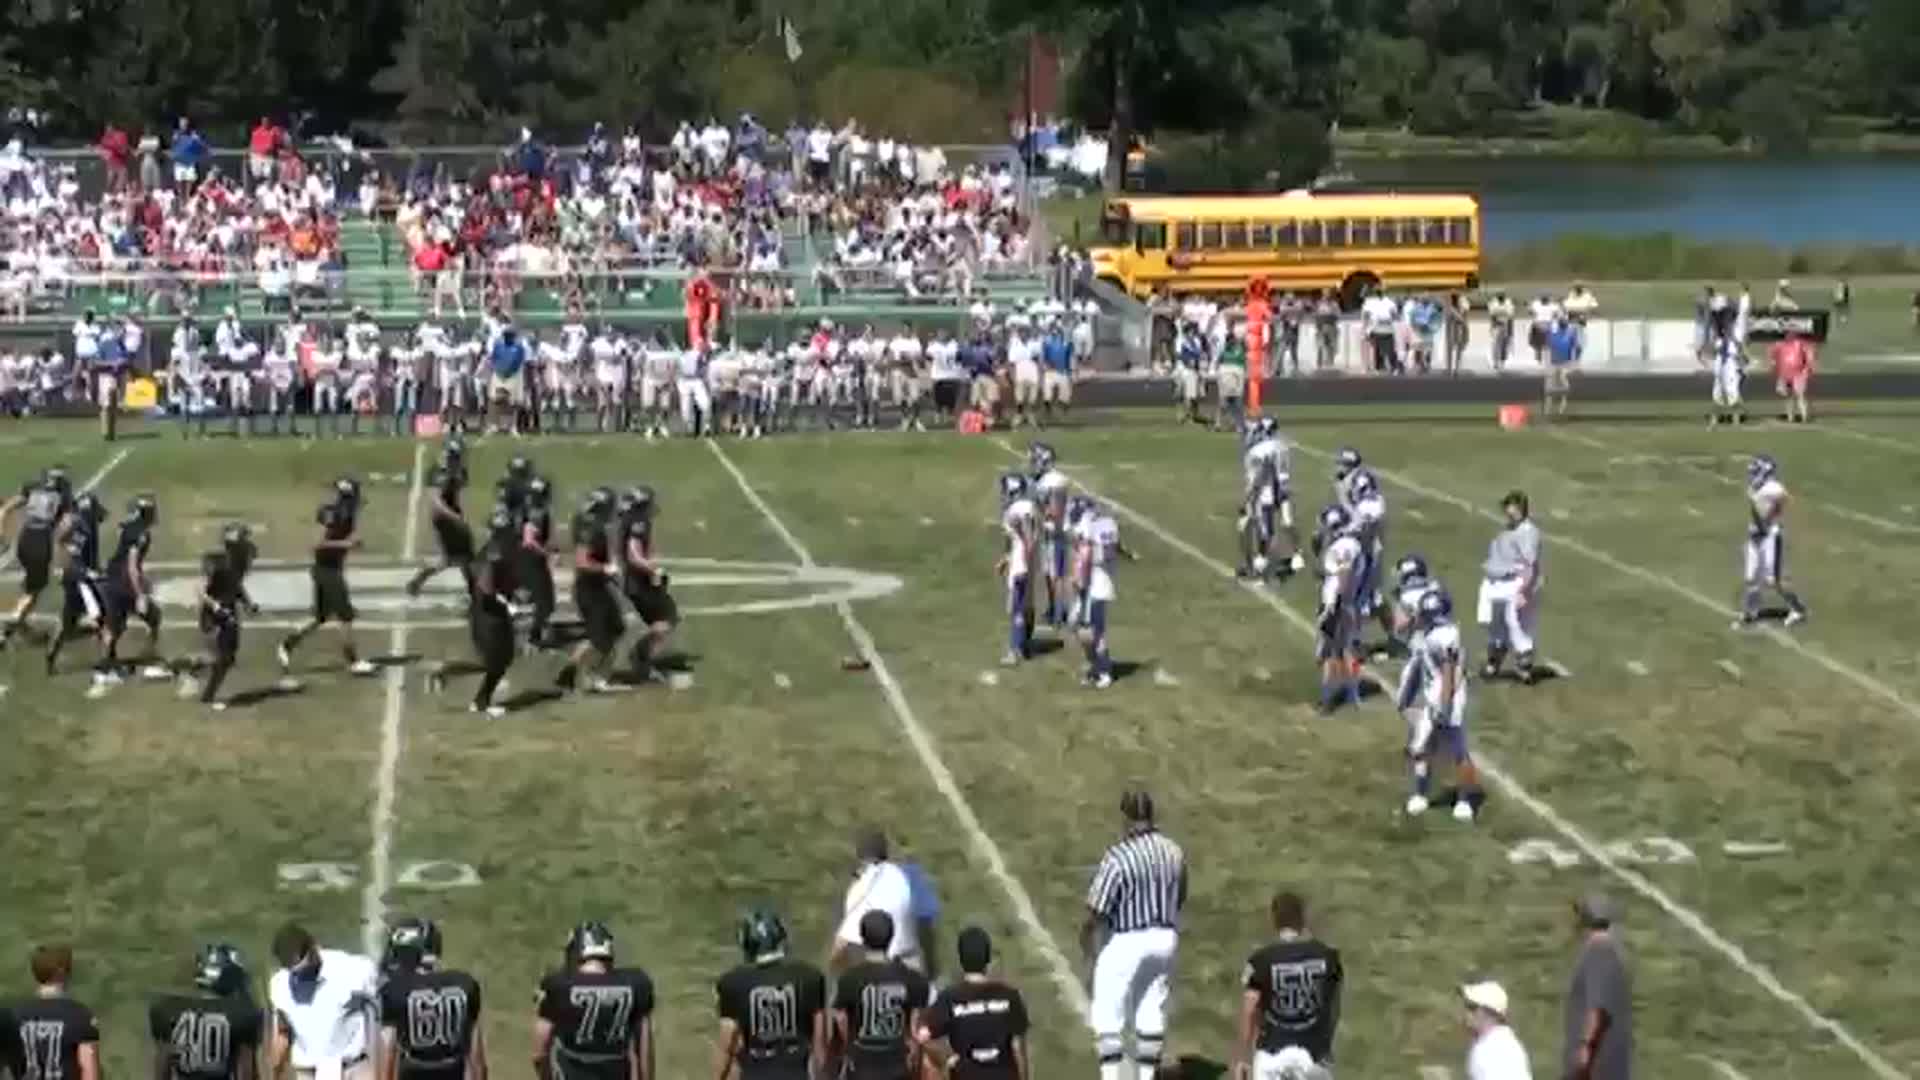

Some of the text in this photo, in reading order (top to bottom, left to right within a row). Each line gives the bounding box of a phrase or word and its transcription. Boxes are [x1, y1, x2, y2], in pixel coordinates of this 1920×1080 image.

[408, 987, 467, 1046] 60
[569, 985, 632, 1044] 77
[749, 984, 797, 1040] 61
[859, 984, 906, 1039] 15
[20, 1020, 64, 1079] 17
[171, 1011, 230, 1072] 40
